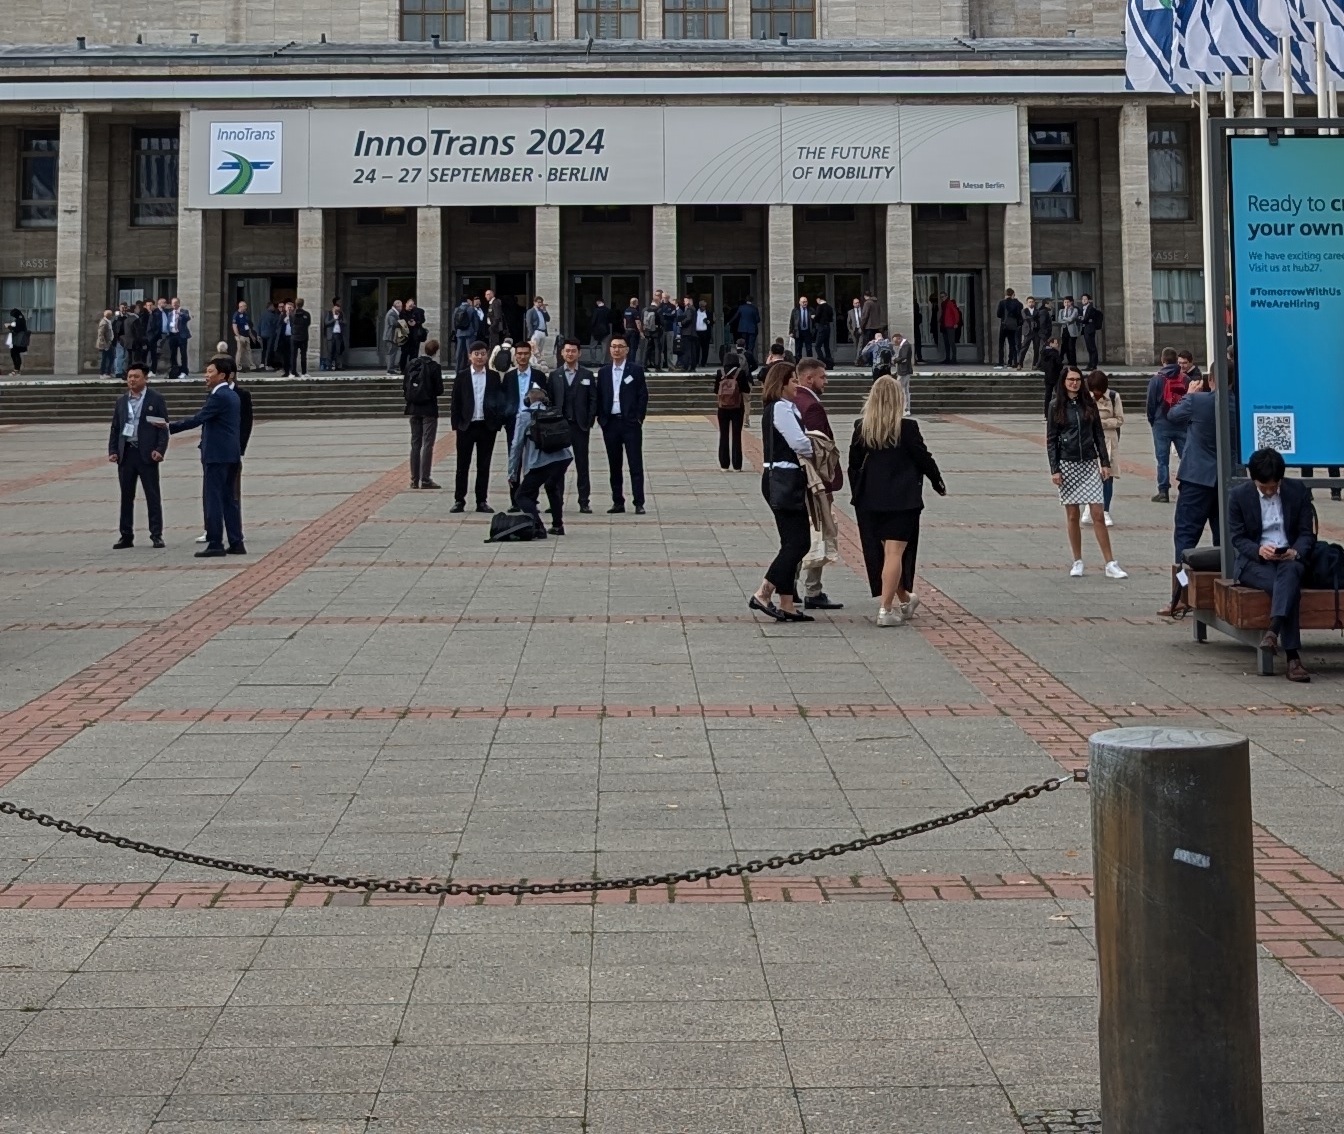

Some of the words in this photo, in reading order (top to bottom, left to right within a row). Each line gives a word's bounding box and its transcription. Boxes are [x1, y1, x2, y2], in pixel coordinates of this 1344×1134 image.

[217, 128, 276, 141] InnoTrans
[354, 129, 515, 157] InnoTrans
[526, 128, 605, 155] 2024
[797, 146, 826, 159] THE
[831, 146, 890, 159] FUTURE
[353, 168, 377, 184] 24
[397, 168, 422, 183] 27
[428, 167, 534, 183] SEPTEMBER
[547, 167, 609, 182] BERLIN
[792, 167, 814, 180] OF
[817, 166, 895, 179] MOBILITY
[1248, 194, 1303, 216] Ready
[1307, 196, 1326, 212] to
[1248, 222, 1295, 241] your
[1299, 222, 1344, 236] own
[1248, 251, 1263, 260] We
[1264, 251, 1286, 260] have
[1287, 251, 1321, 262] exciting
[20, 259, 49, 268] KASSE
[1249, 263, 1268, 272] Visit
[1281, 264, 1291, 272] at
[1292, 263, 1322, 272] hub27.
[1249, 287, 1342, 296] #TomorrowWithUs
[1250, 299, 1320, 310] #WeAreHiring
